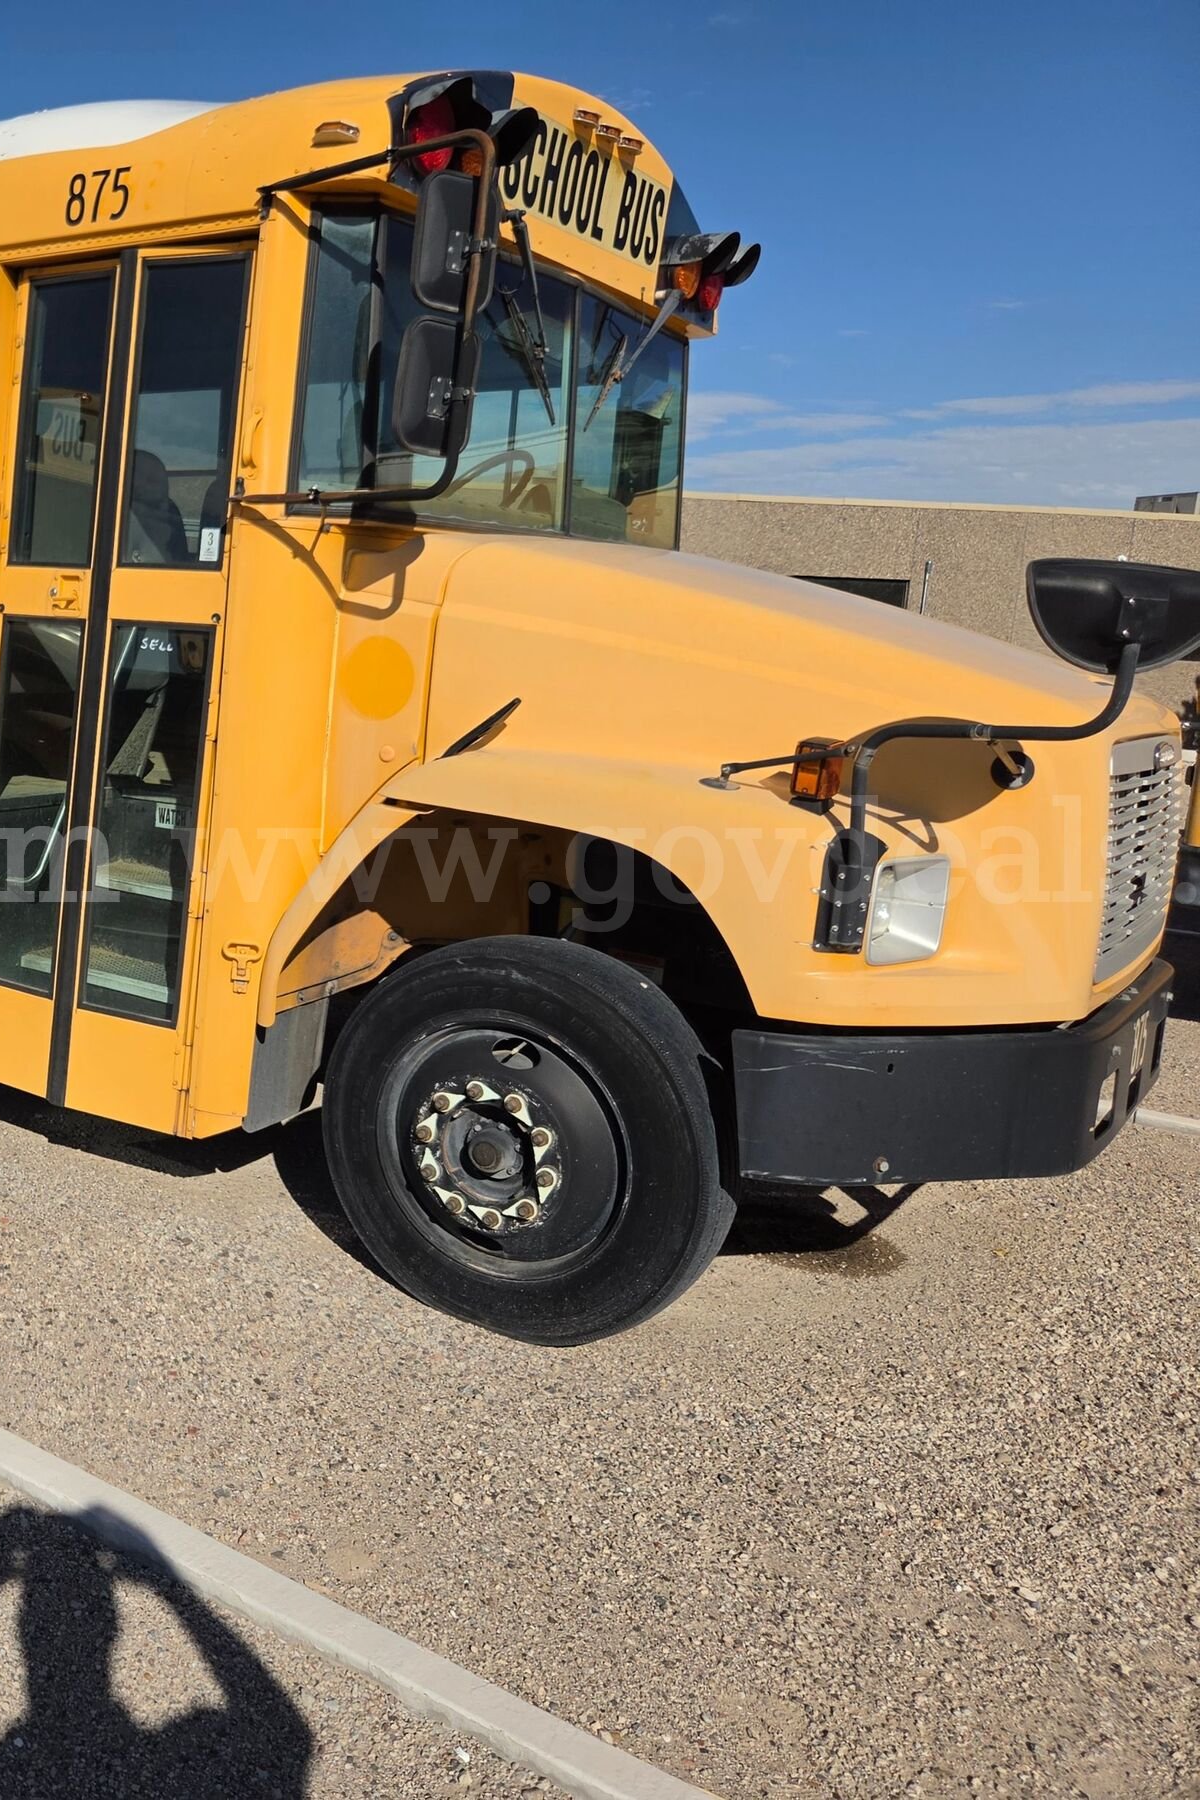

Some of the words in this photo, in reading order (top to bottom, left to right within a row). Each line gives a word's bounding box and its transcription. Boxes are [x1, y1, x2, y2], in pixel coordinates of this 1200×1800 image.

[65, 166, 132, 227] 875
[613, 170, 666, 265] BUS
[140, 637, 174, 652] SELL
[158, 807, 186, 827] WATCH
